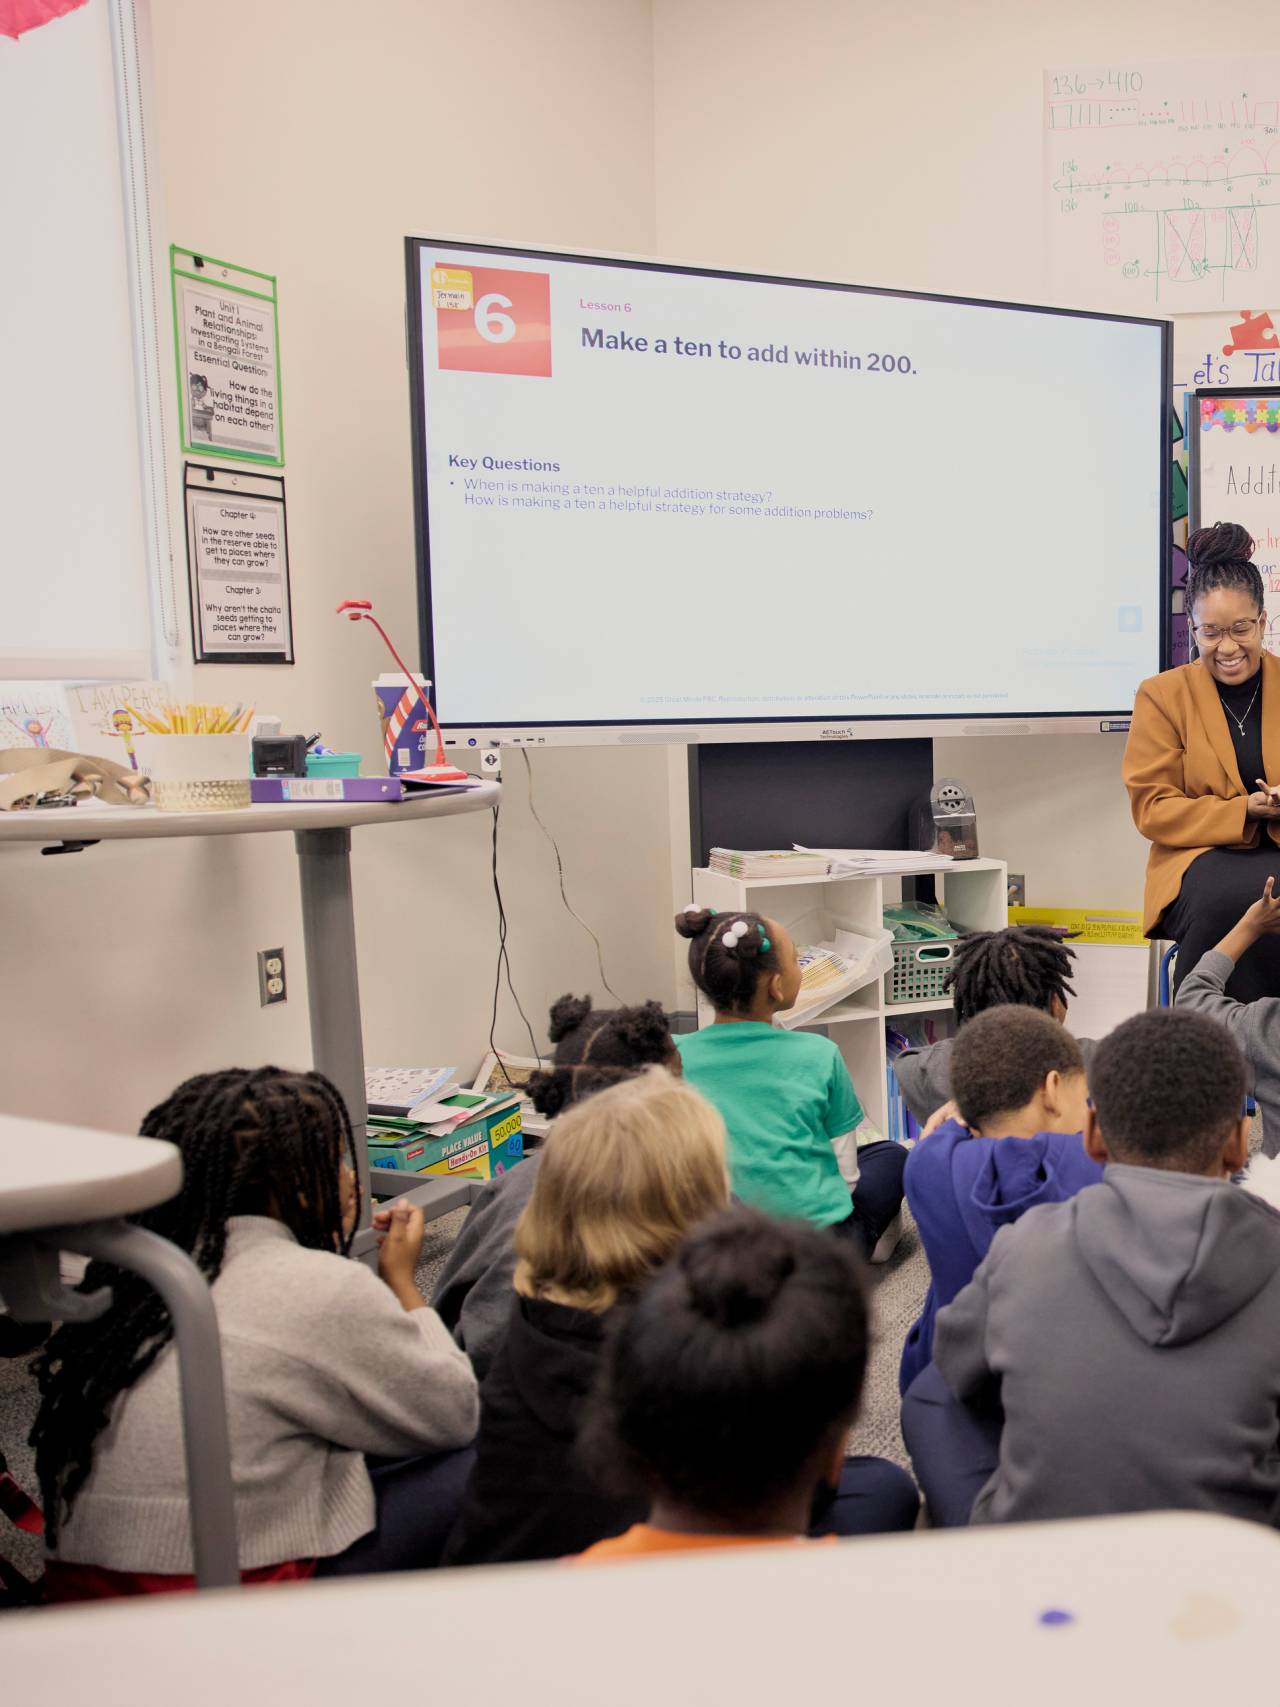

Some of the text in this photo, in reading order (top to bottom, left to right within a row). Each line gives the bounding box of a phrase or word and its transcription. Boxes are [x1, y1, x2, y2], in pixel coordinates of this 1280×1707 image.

[580, 299, 633, 313] Lesson 6
[474, 293, 516, 343] 6
[582, 327, 918, 375] Make a ten to add within 200.
[193, 351, 268, 377] Essential Question
[215, 414, 274, 432] on each other?
[449, 454, 560, 472] Key Questions
[464, 478, 772, 504] When is making a ten a helpful addition strategy?
[220, 509, 248, 520] Chapter
[464, 494, 873, 520] How is making a ten a helpful strategy for some addition problems?
[214, 556, 269, 568] they can grow?
[442, 1131, 483, 1157] PLACE VALUE
[450, 1149, 477, 1167] Hands-On
